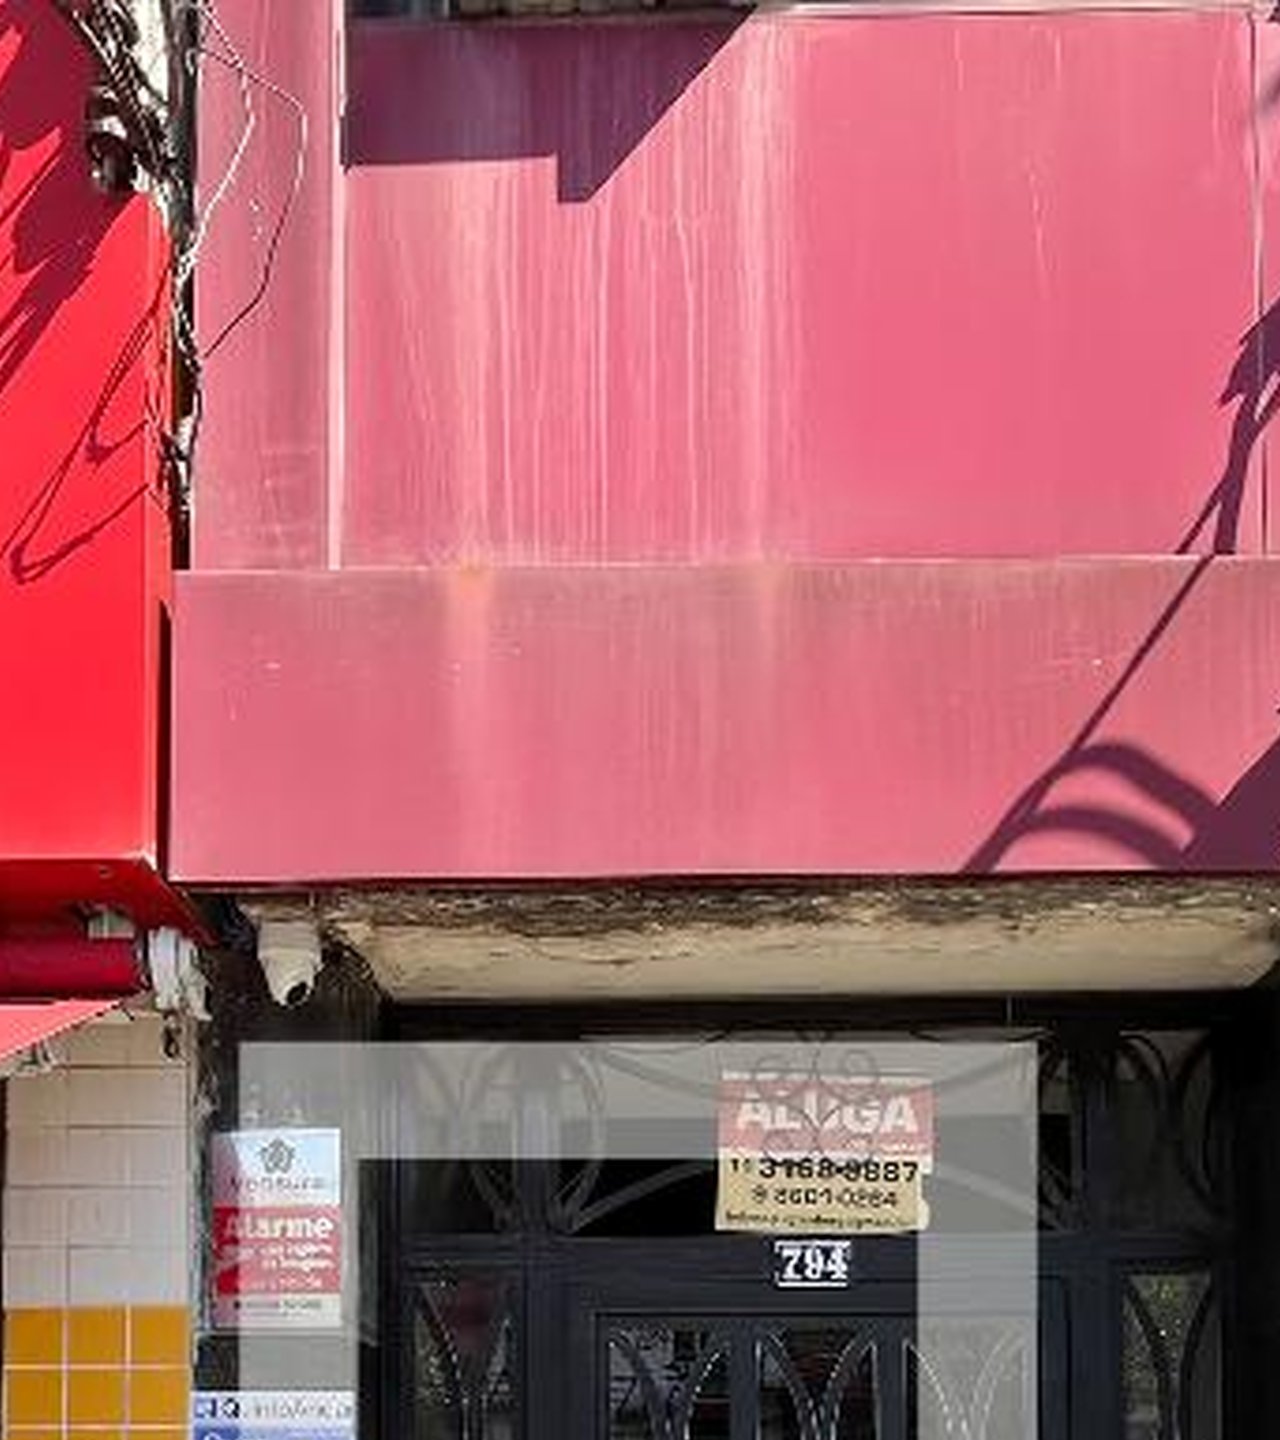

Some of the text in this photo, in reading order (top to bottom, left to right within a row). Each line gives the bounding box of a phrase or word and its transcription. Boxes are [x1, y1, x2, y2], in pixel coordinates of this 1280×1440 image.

[736, 1088, 919, 1133] ALUGA
[223, 1215, 333, 1237] Alarme
[781, 1249, 848, 1280] 794
